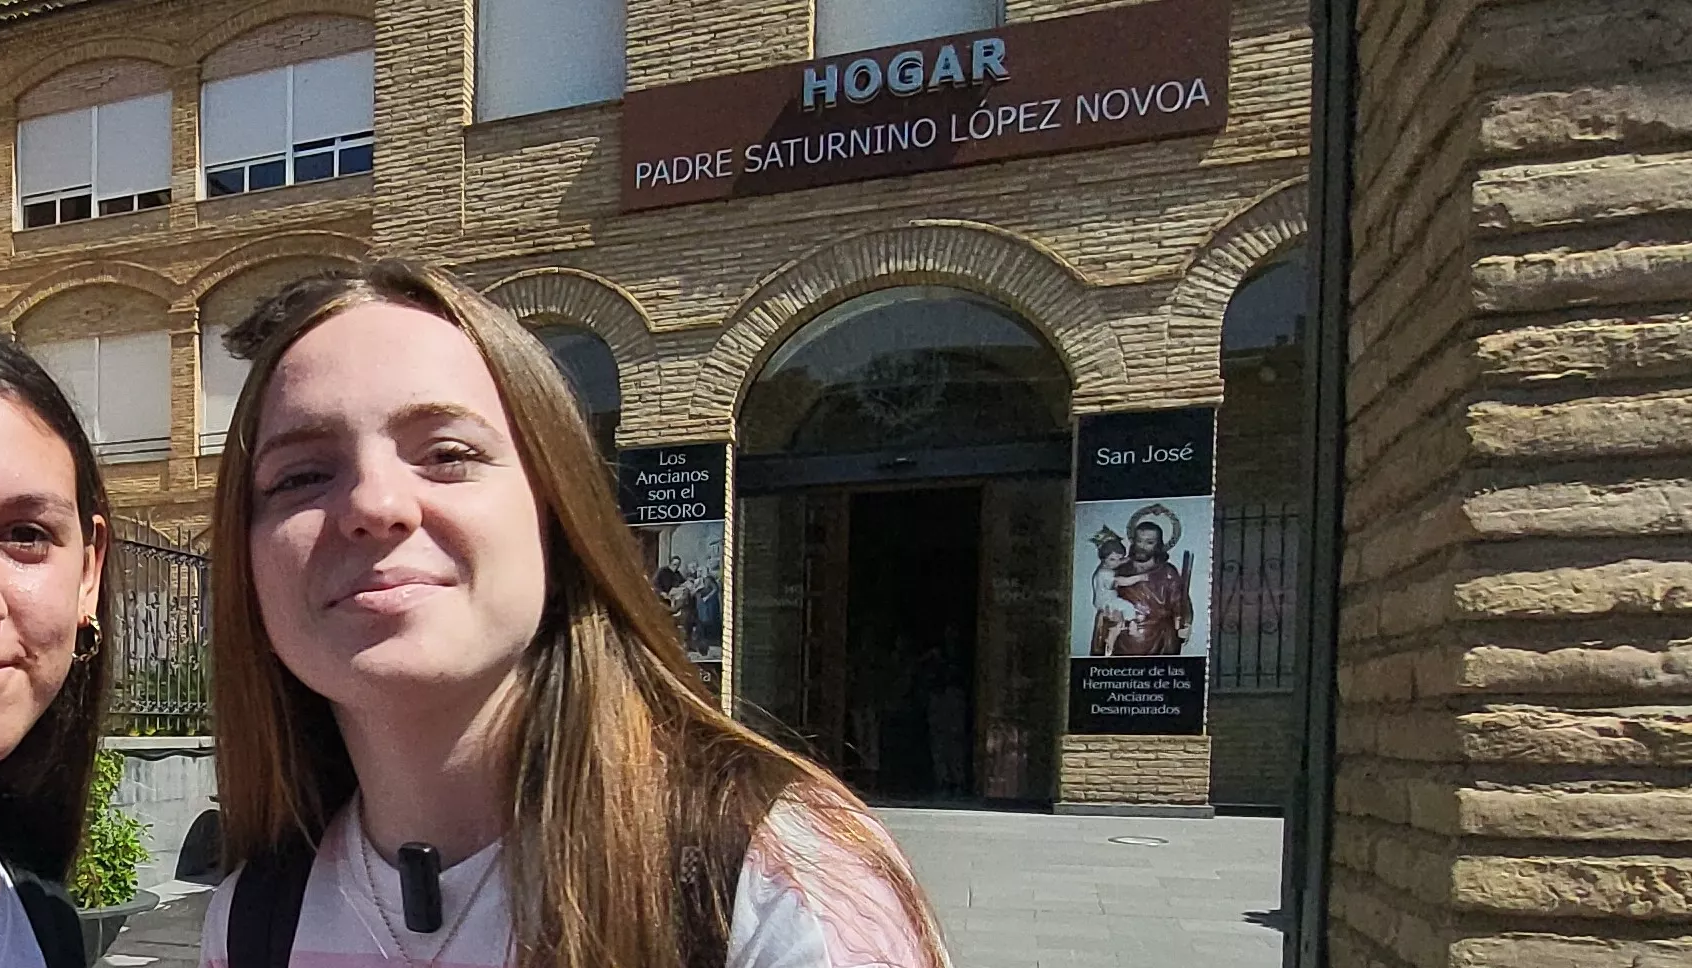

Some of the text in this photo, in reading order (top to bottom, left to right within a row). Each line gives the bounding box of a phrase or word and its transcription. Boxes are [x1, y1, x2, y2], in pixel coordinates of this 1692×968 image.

[802, 37, 1010, 111] HOGAR
[635, 77, 1211, 190] PADRE SATURNINO LÓPEZ NOVOA
[660, 451, 686, 466] Los
[1096, 441, 1194, 467] San José
[636, 469, 709, 485] Ancianos
[648, 483, 695, 501] son el
[636, 502, 706, 521] TESORO
[1090, 665, 1185, 677] Protector de las
[1082, 677, 1191, 690] Hermanitas de los
[1106, 690, 1165, 702] Ancianos
[1090, 702, 1181, 716] Desamparados
